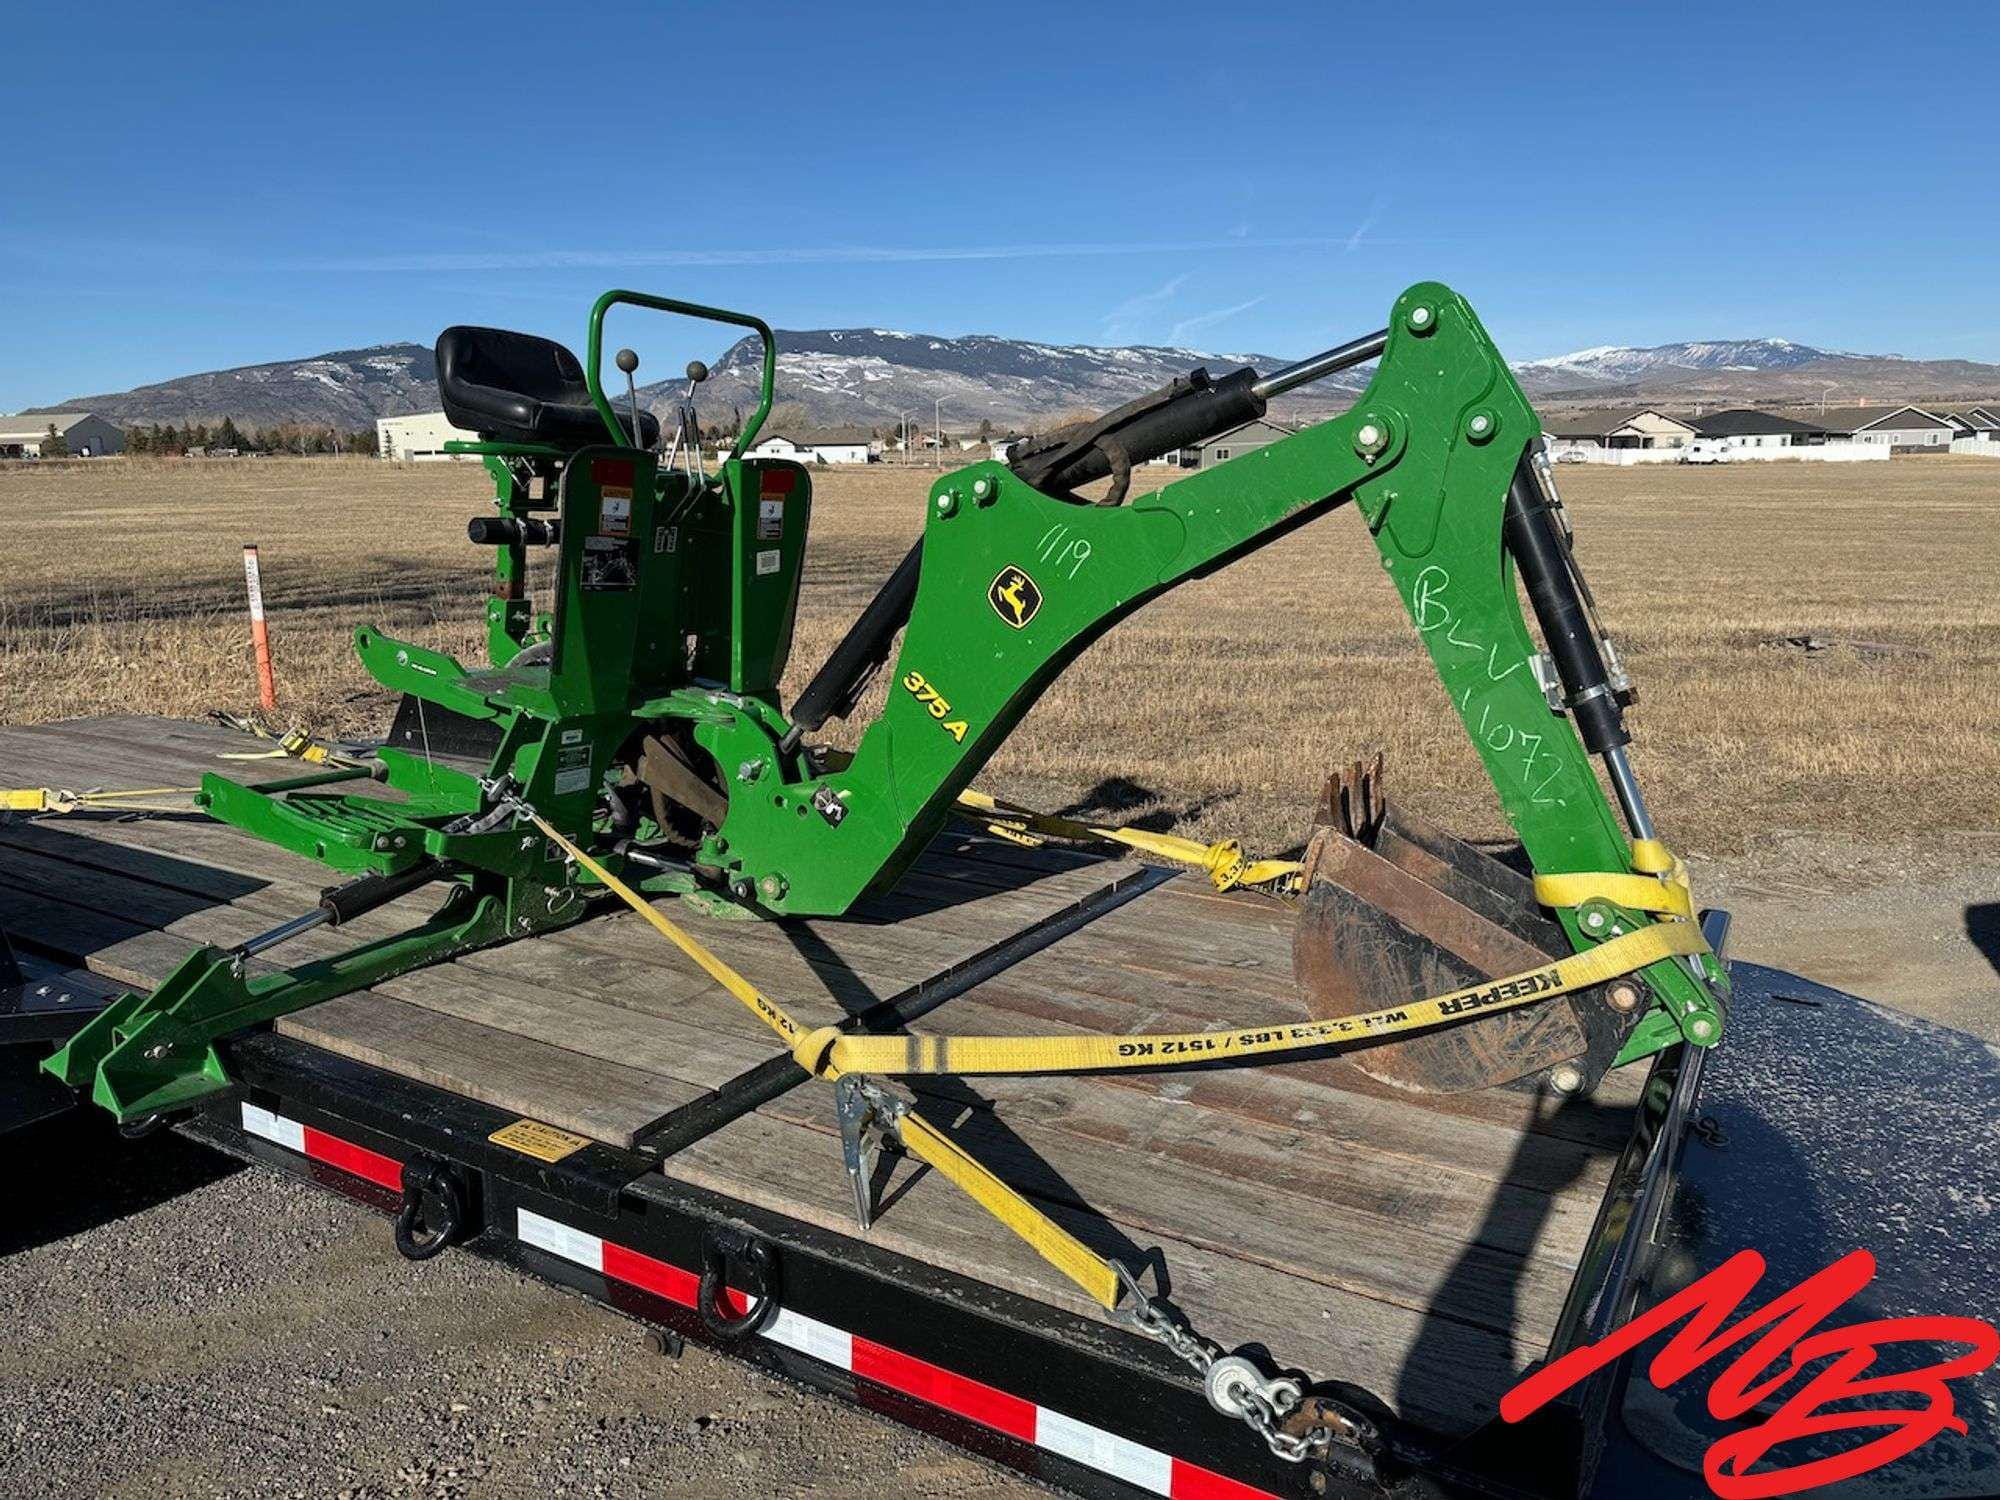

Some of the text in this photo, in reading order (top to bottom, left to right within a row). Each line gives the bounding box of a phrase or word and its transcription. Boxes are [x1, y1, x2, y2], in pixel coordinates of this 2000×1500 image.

[1437, 968, 1564, 1015] KEEPER
[1160, 1038, 1216, 1054] 1512
[1239, 1030, 1284, 1047] LBS
[1118, 1042, 1154, 1057] KG
